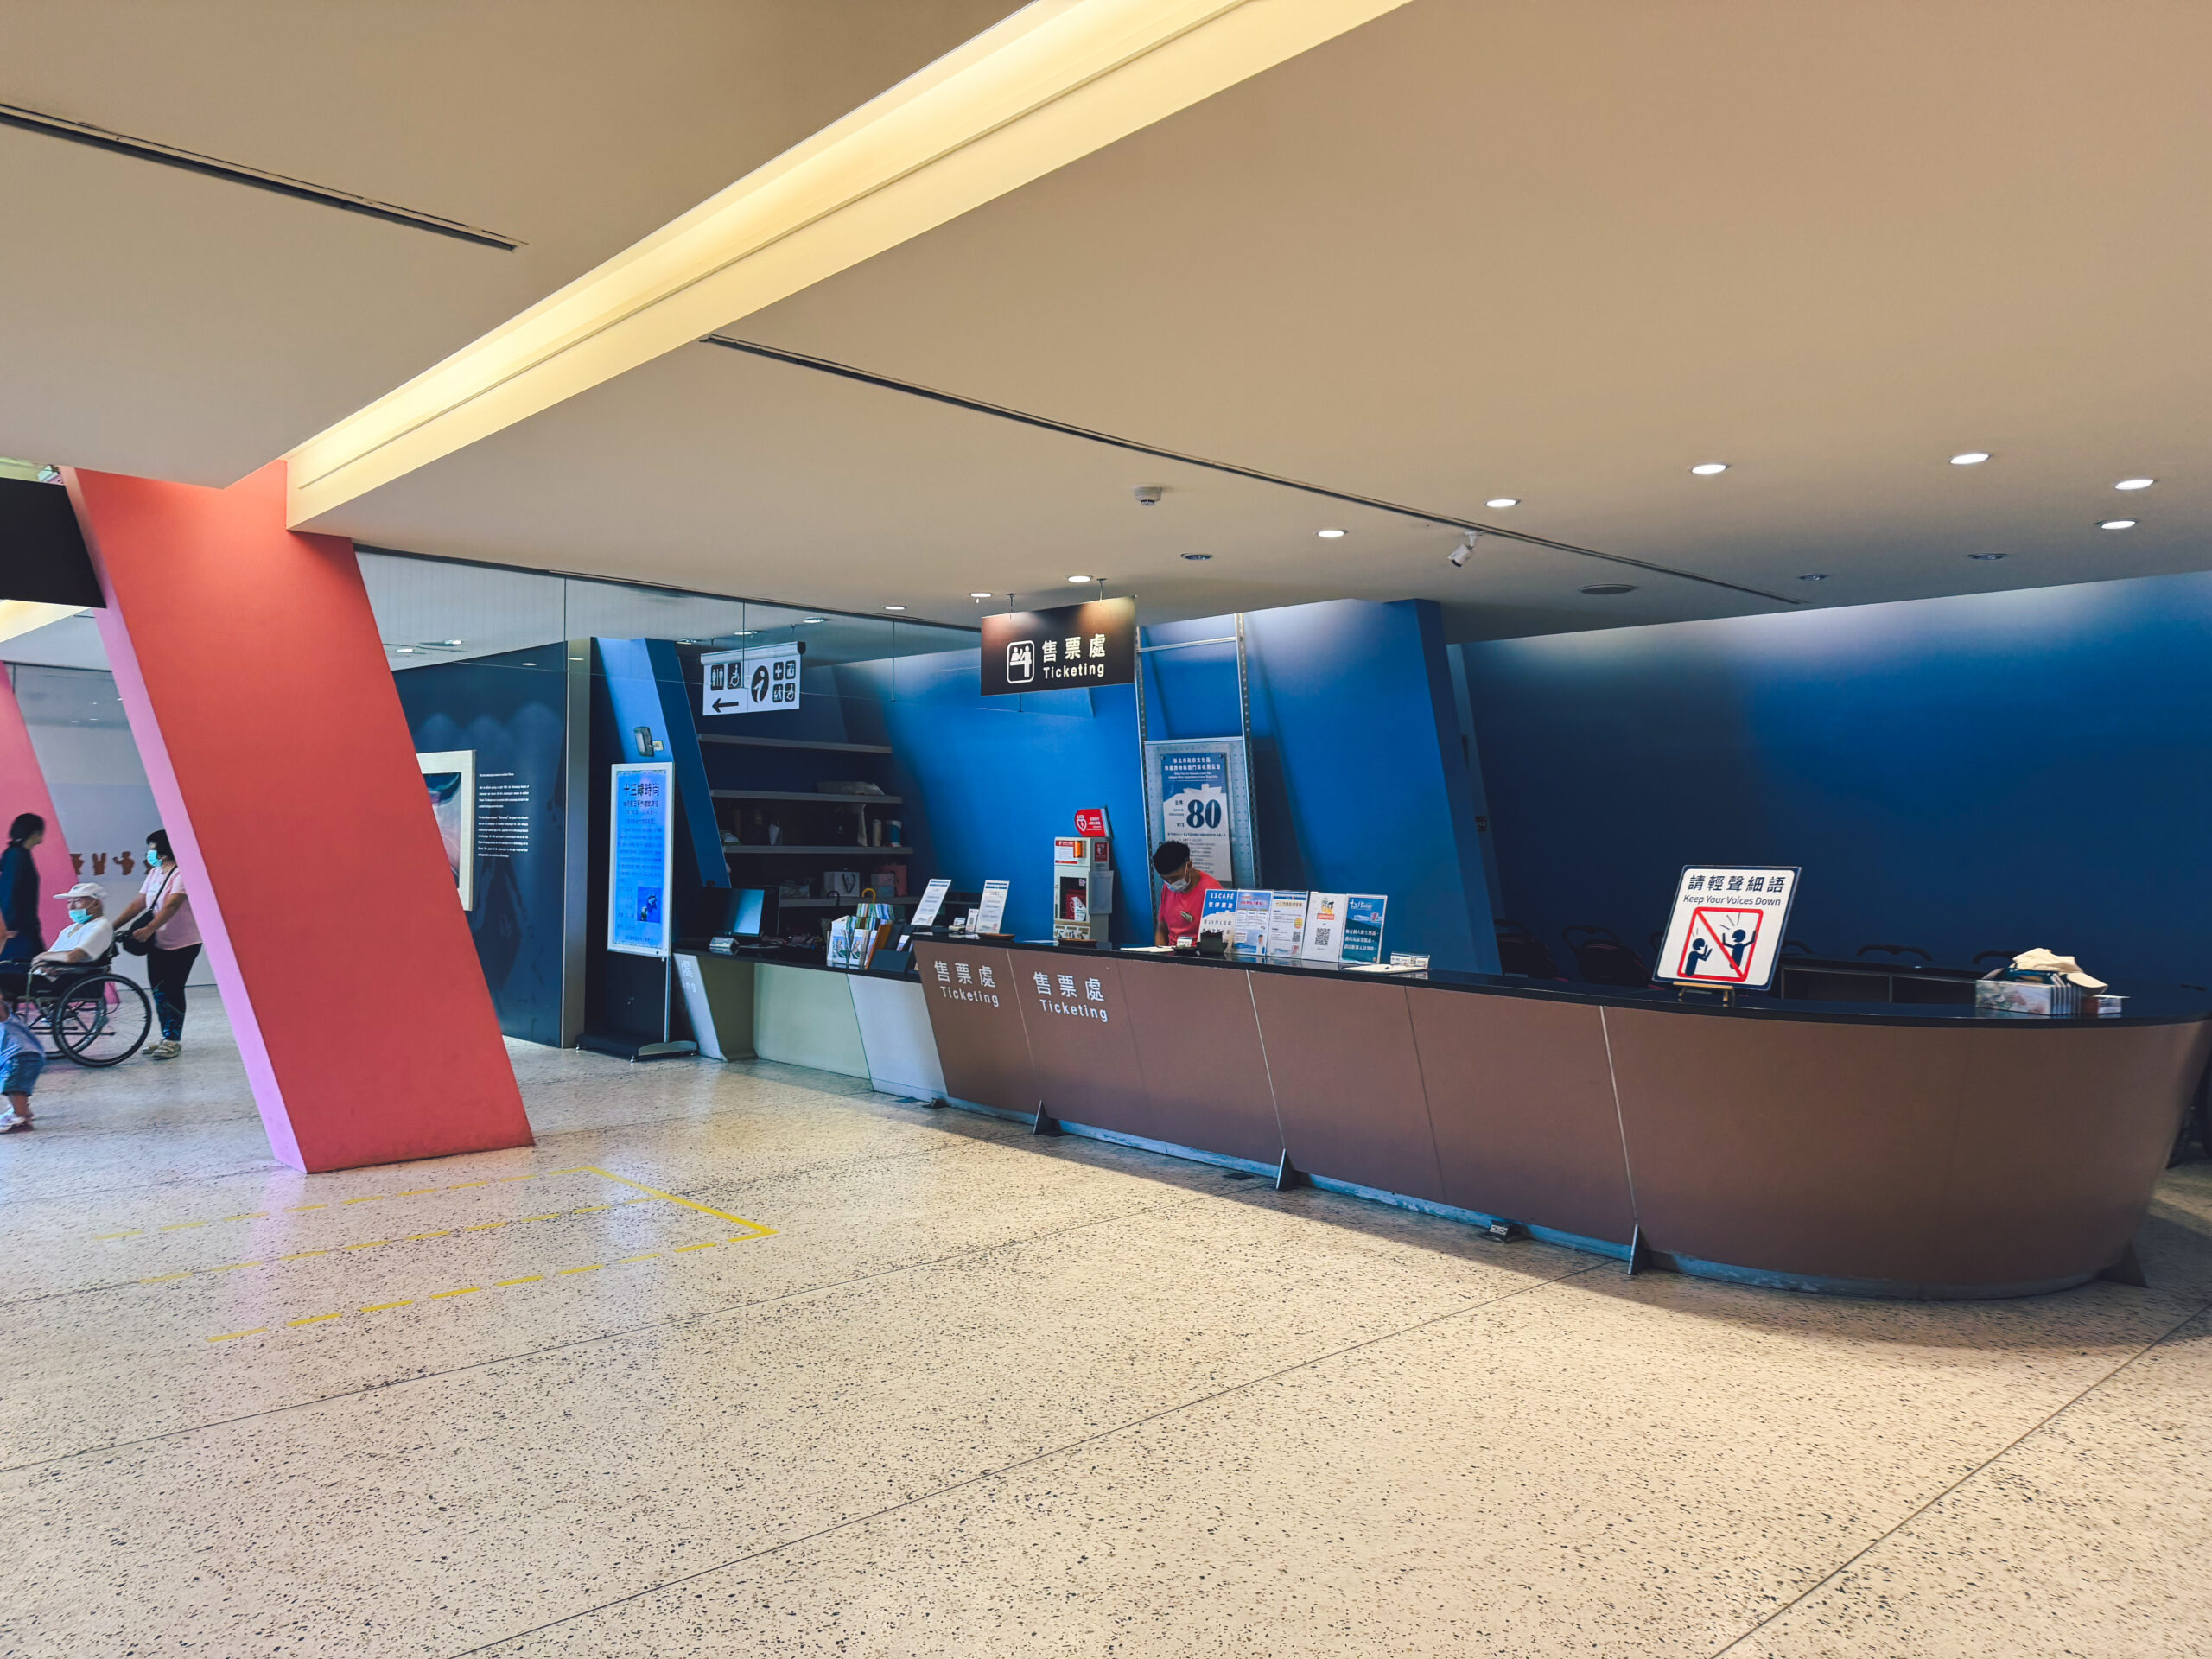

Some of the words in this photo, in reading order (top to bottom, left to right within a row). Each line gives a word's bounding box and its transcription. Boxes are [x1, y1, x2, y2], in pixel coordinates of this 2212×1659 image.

[1041, 633, 1106, 663] 售票處
[1043, 663, 1104, 679] Ticketing
[1186, 799, 1222, 829] 80
[1688, 874, 1786, 893] 請輕聲細語
[1683, 894, 1705, 905] Keep
[1707, 895, 1725, 904] Your
[1726, 896, 1754, 905] Voices
[1755, 897, 1781, 906] Down
[933, 960, 996, 988] 售票處
[940, 986, 1000, 1007] Ticketing
[1033, 971, 1105, 1002] 售票處
[1039, 999, 1109, 1023] Ticketing
